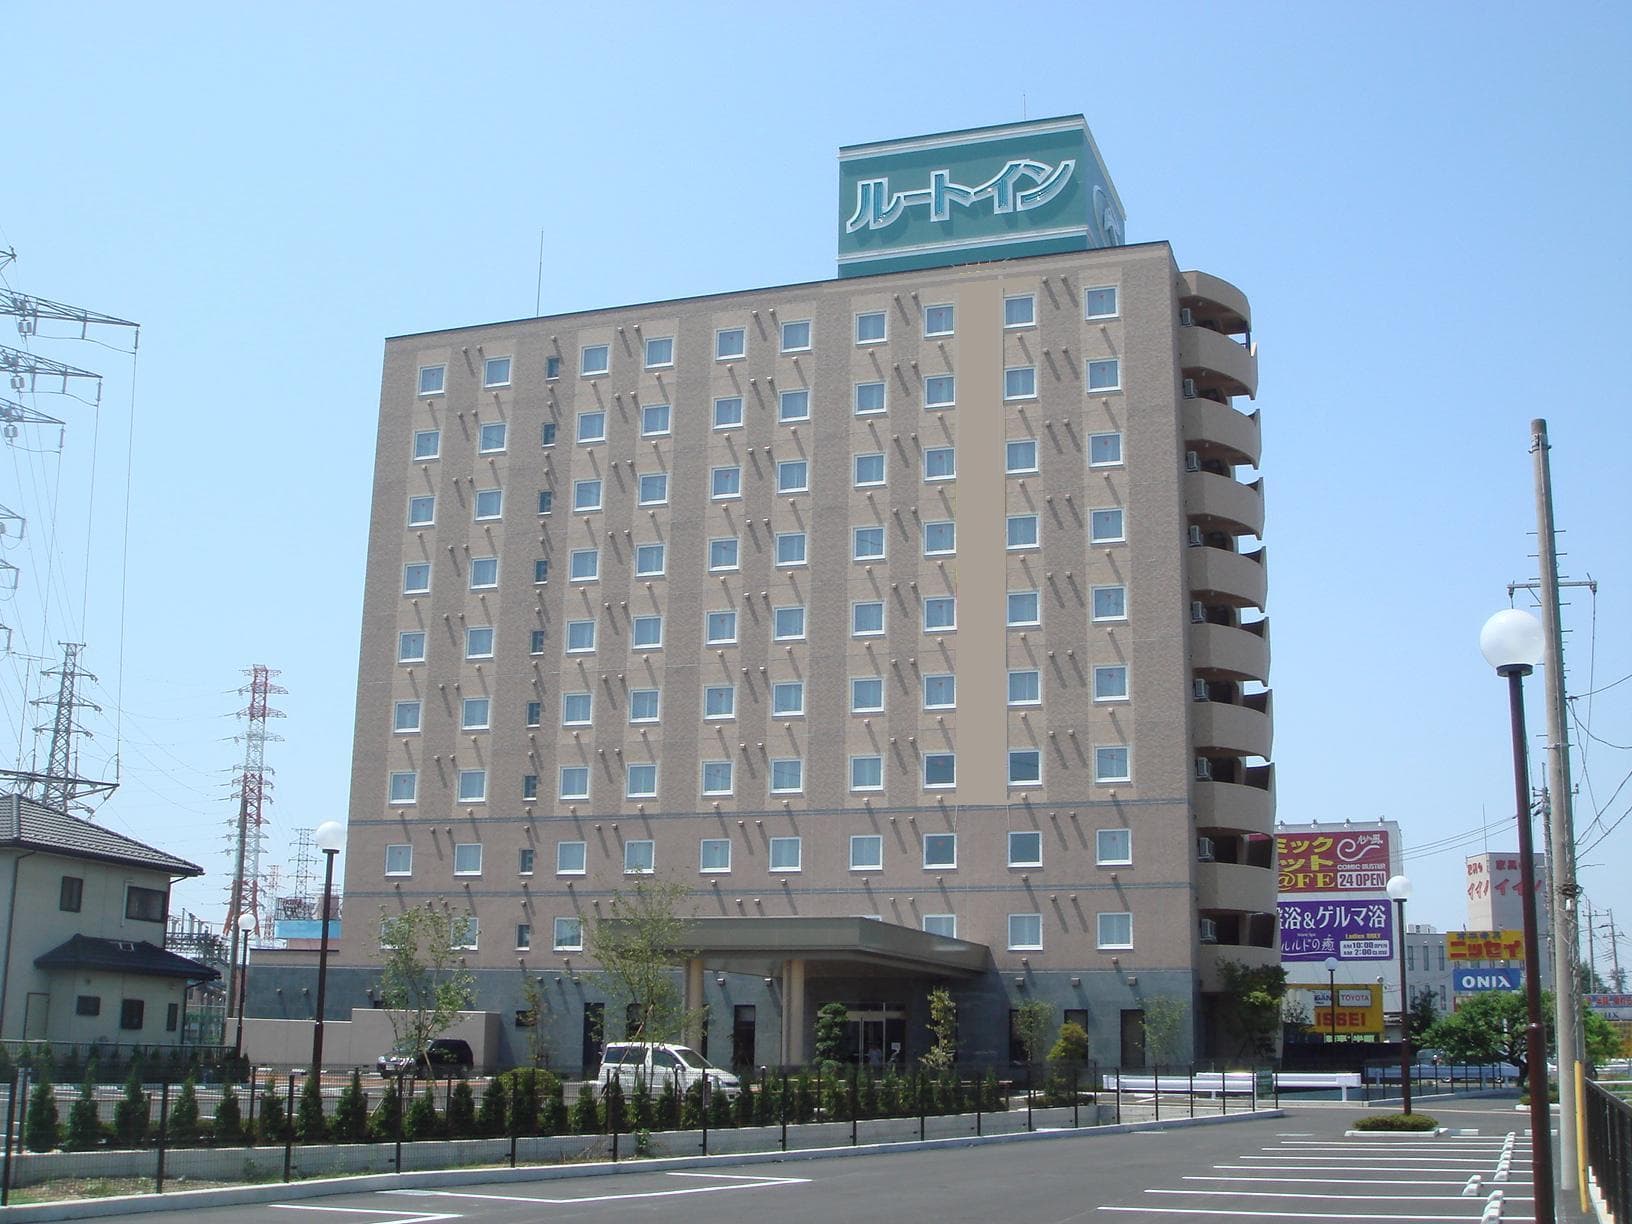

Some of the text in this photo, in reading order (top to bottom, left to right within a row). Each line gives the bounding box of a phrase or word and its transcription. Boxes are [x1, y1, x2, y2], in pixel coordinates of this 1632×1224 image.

[845, 158, 1076, 234] ルートイン
[1339, 872, 1385, 886] 24 OPEN
[1449, 940, 1521, 958] ニッセイ
